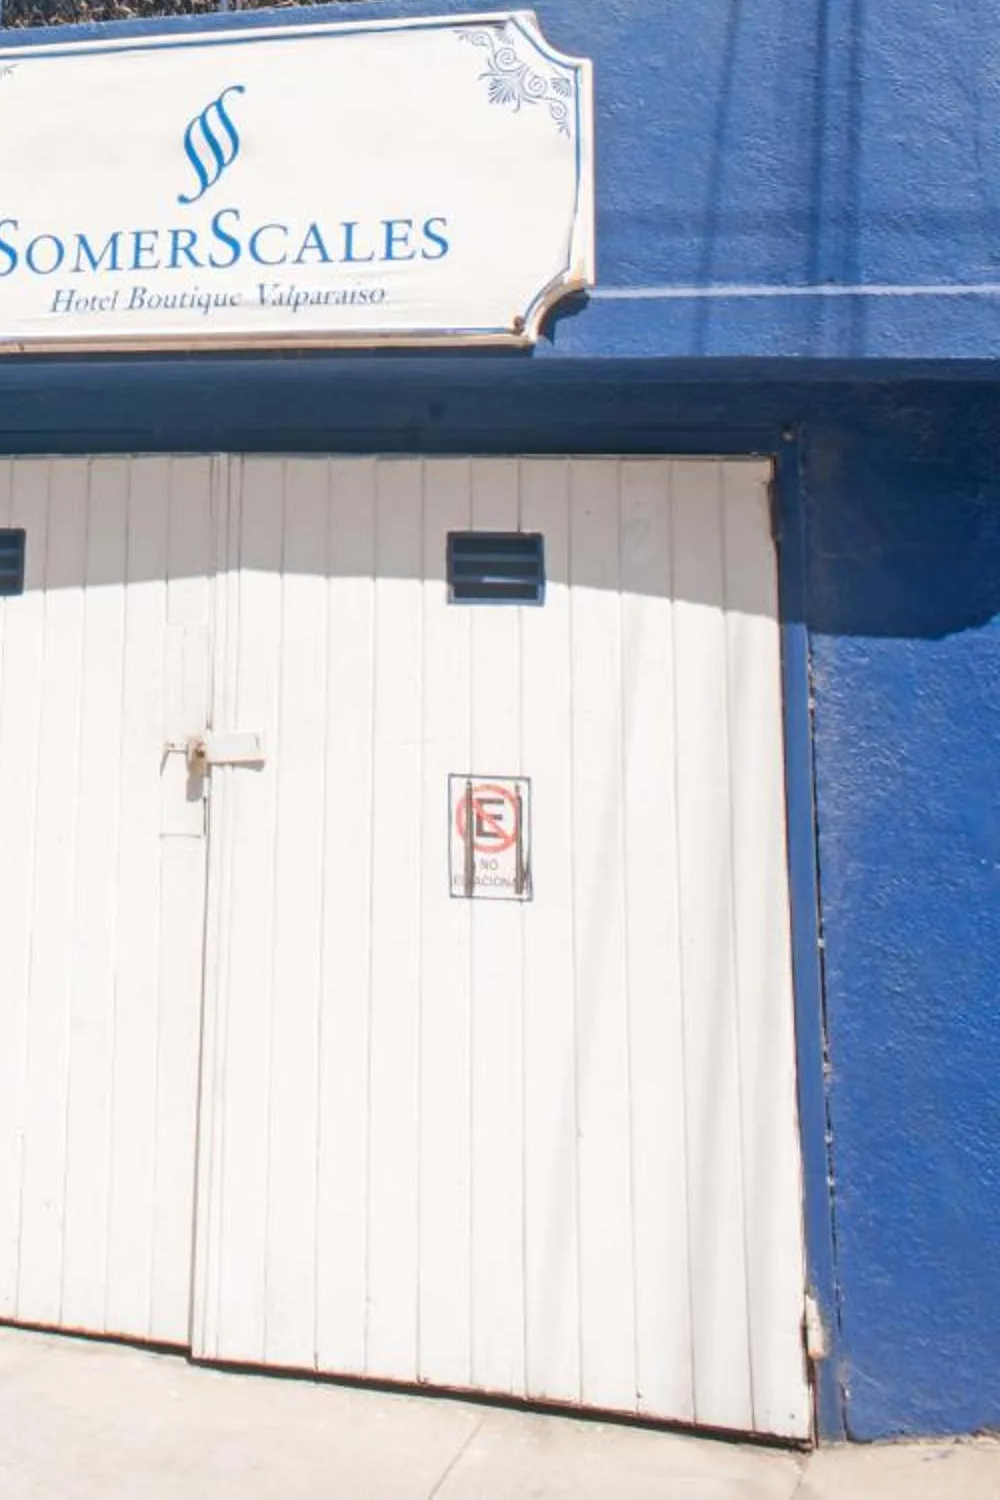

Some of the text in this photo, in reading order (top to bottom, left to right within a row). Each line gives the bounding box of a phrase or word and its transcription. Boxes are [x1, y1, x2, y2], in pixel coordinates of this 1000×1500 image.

[51, 288, 119, 312] Hotel
[126, 285, 240, 315] Boutique
[480, 857, 499, 870] NO
